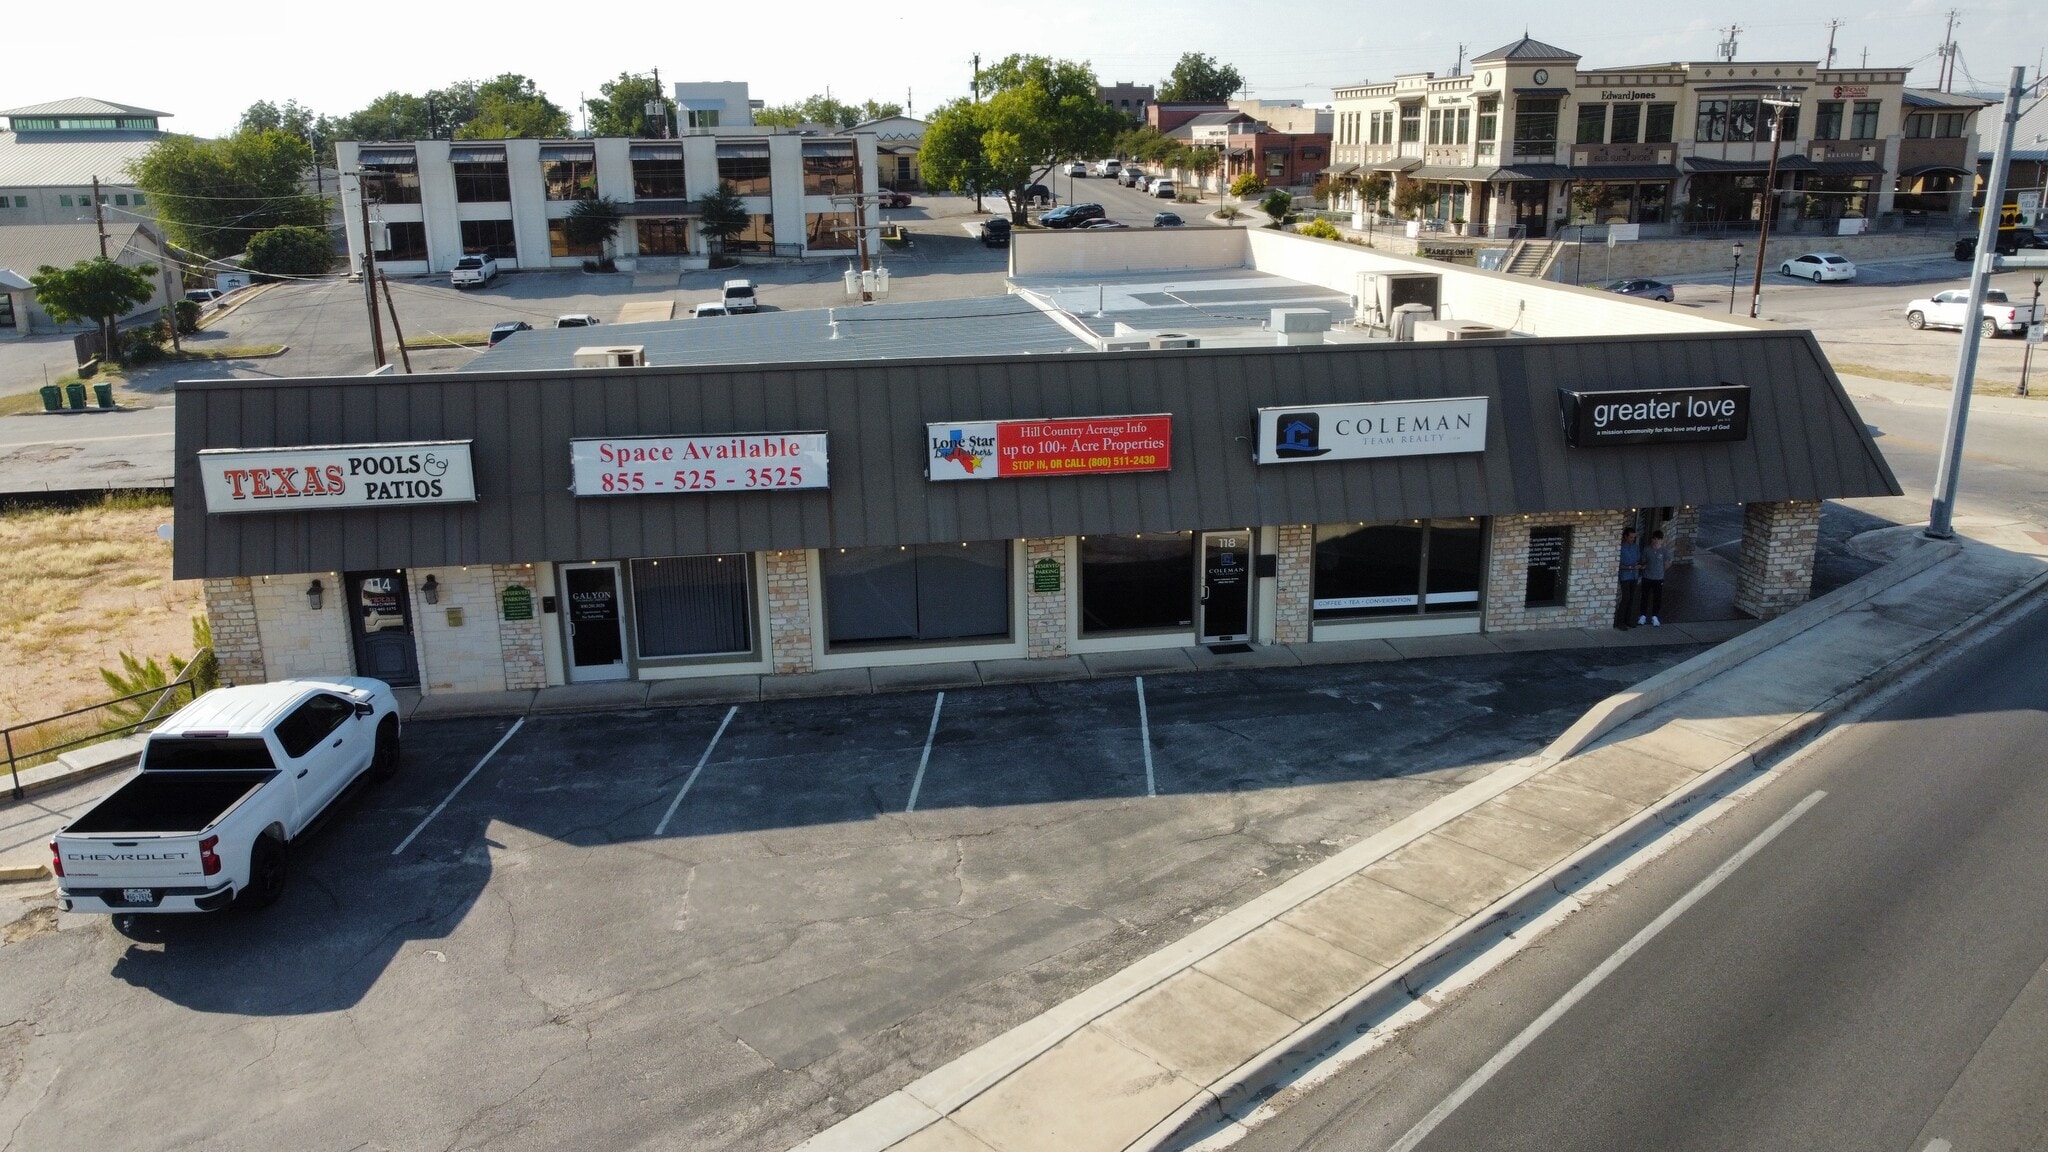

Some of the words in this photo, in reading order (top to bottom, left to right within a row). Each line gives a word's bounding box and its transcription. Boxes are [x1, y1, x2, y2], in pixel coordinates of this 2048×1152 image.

[1601, 91, 1631, 100] Edward
[1631, 91, 1656, 100] Jones
[1594, 398, 1681, 427] greater
[1687, 396, 1735, 418] love
[1021, 426, 1040, 438] Hill
[1042, 424, 1084, 439] Country
[1086, 423, 1125, 437] Acreage
[1126, 421, 1147, 433] Info
[1335, 413, 1472, 436] COLEMAN
[1624, 427, 1654, 435] community
[932, 438, 966, 450] Lone
[969, 435, 995, 448] Star
[1003, 446, 1018, 460] up
[1021, 443, 1035, 455] to
[1038, 440, 1067, 454] 100+
[1070, 438, 1100, 452] Acre
[1102, 436, 1165, 454] Properties
[1363, 437, 1395, 446] TEAM
[1401, 434, 1444, 444] REALTY
[599, 443, 673, 467] Space
[683, 438, 801, 461] Available
[348, 454, 421, 476] POOLS
[423, 453, 449, 477] &
[1012, 460, 1035, 471] STOP
[1036, 460, 1049, 470] IN,
[1050, 459, 1063, 469] OR
[1064, 458, 1086, 468] CALL
[1088, 457, 1111, 469] (800)
[1113, 455, 1156, 467] 511-2430
[223, 464, 346, 500] TEXAS
[601, 472, 645, 492] 855
[674, 469, 716, 490] 525
[744, 466, 803, 488] 3525
[364, 478, 443, 500] PATIOS
[1219, 538, 1236, 548] 118
[572, 591, 611, 600] GALYON
[1318, 599, 1342, 607] COFFEE
[1365, 596, 1412, 604] CONVERSATION
[68, 853, 189, 861] CHEVROLET
